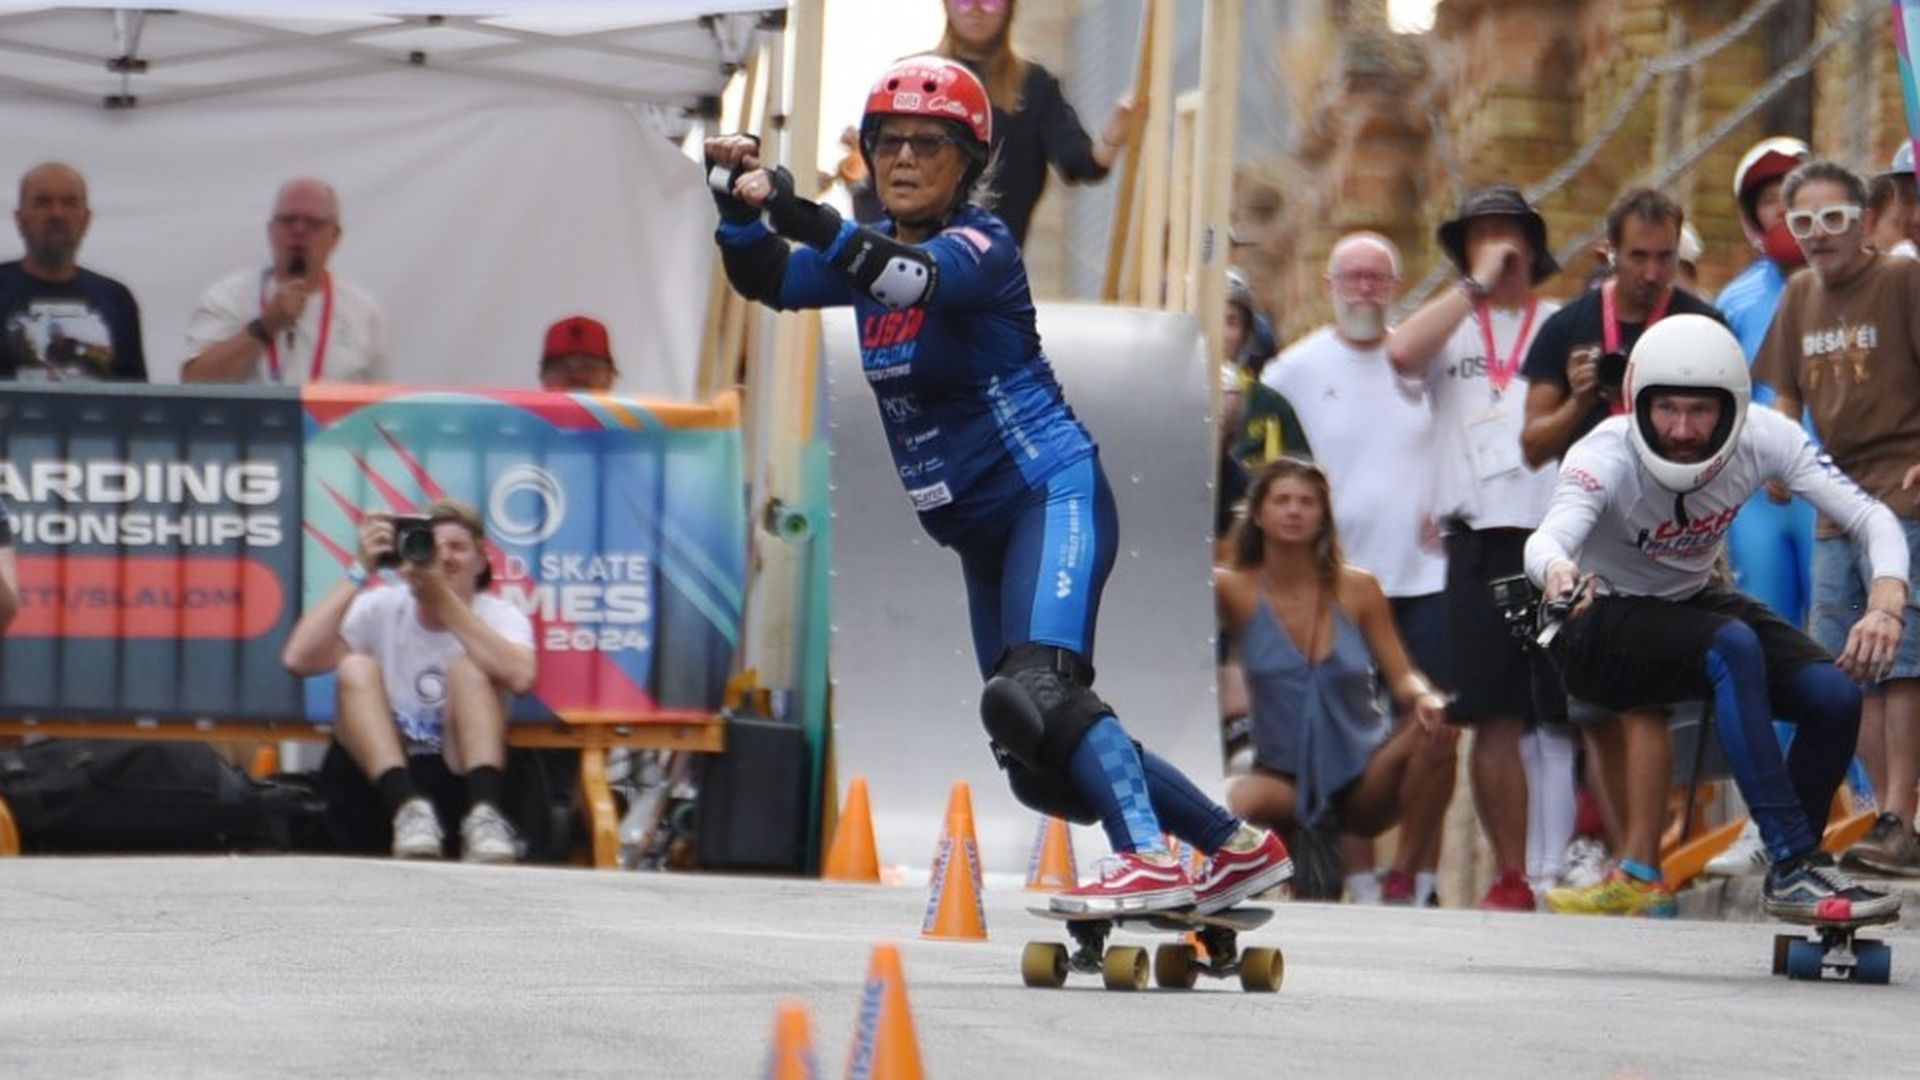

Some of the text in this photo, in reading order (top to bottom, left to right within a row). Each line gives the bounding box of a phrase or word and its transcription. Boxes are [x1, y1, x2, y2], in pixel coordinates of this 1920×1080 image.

[0, 461, 281, 504] ARDING
[541, 555, 648, 581] SKATE
[502, 584, 649, 624] MES
[545, 627, 649, 652] 2024
